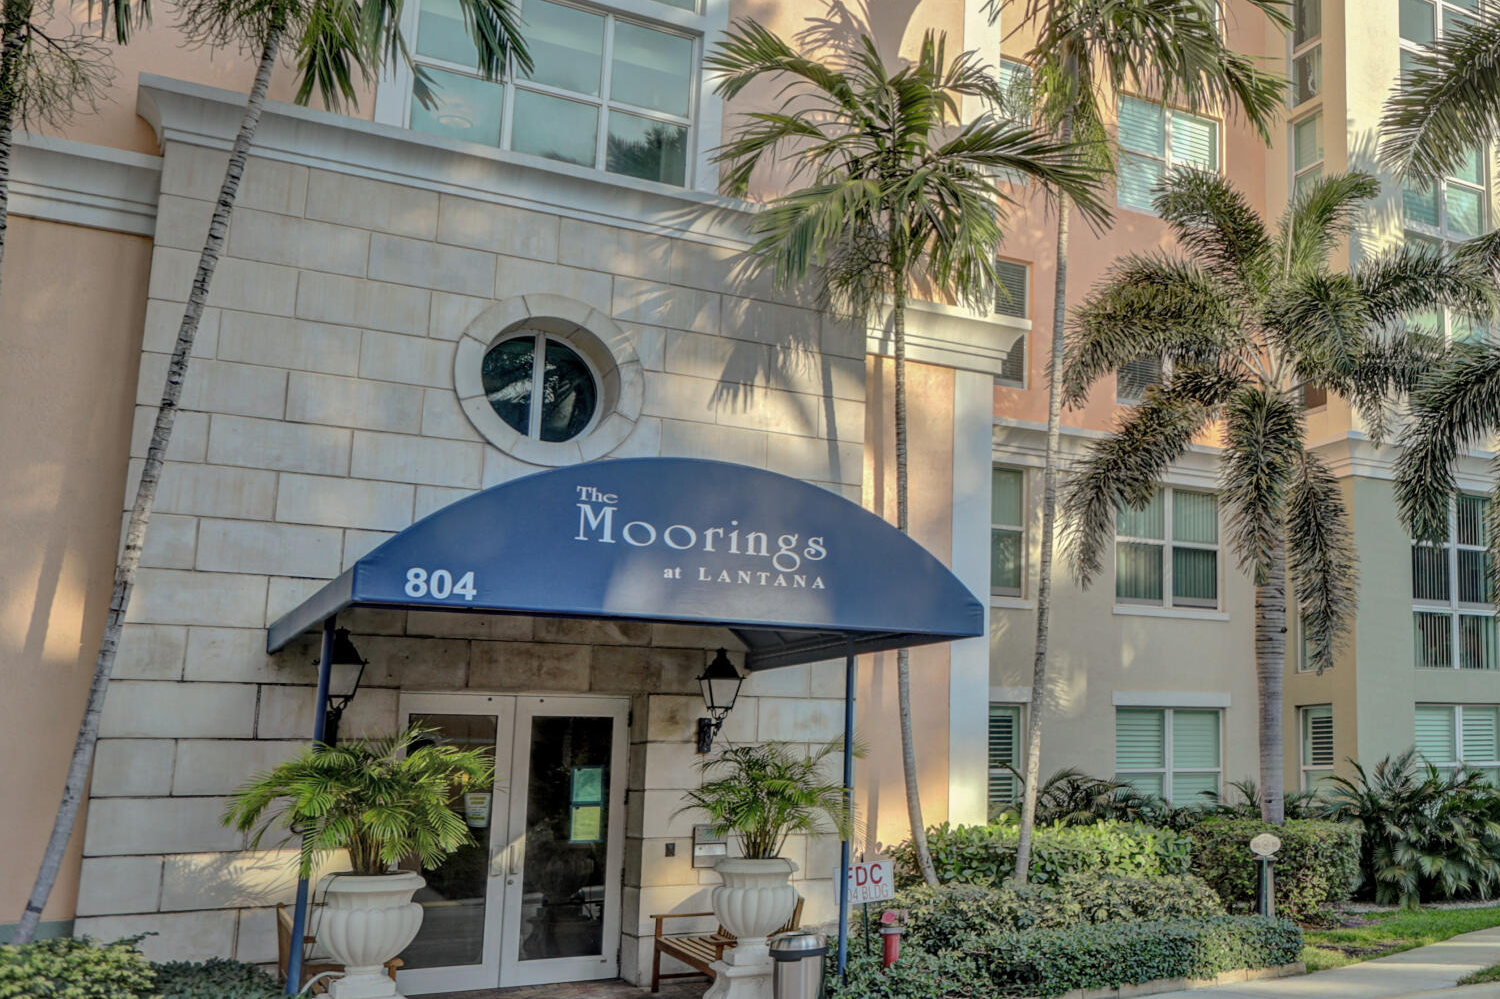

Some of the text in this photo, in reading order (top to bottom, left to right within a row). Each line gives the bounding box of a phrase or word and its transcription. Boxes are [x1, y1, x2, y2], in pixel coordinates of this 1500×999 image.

[576, 485, 619, 504] The
[574, 503, 828, 572] Moorings
[404, 567, 478, 601] 804
[663, 566, 826, 590] at LANTANA
[861, 882, 889, 901] BLDG
